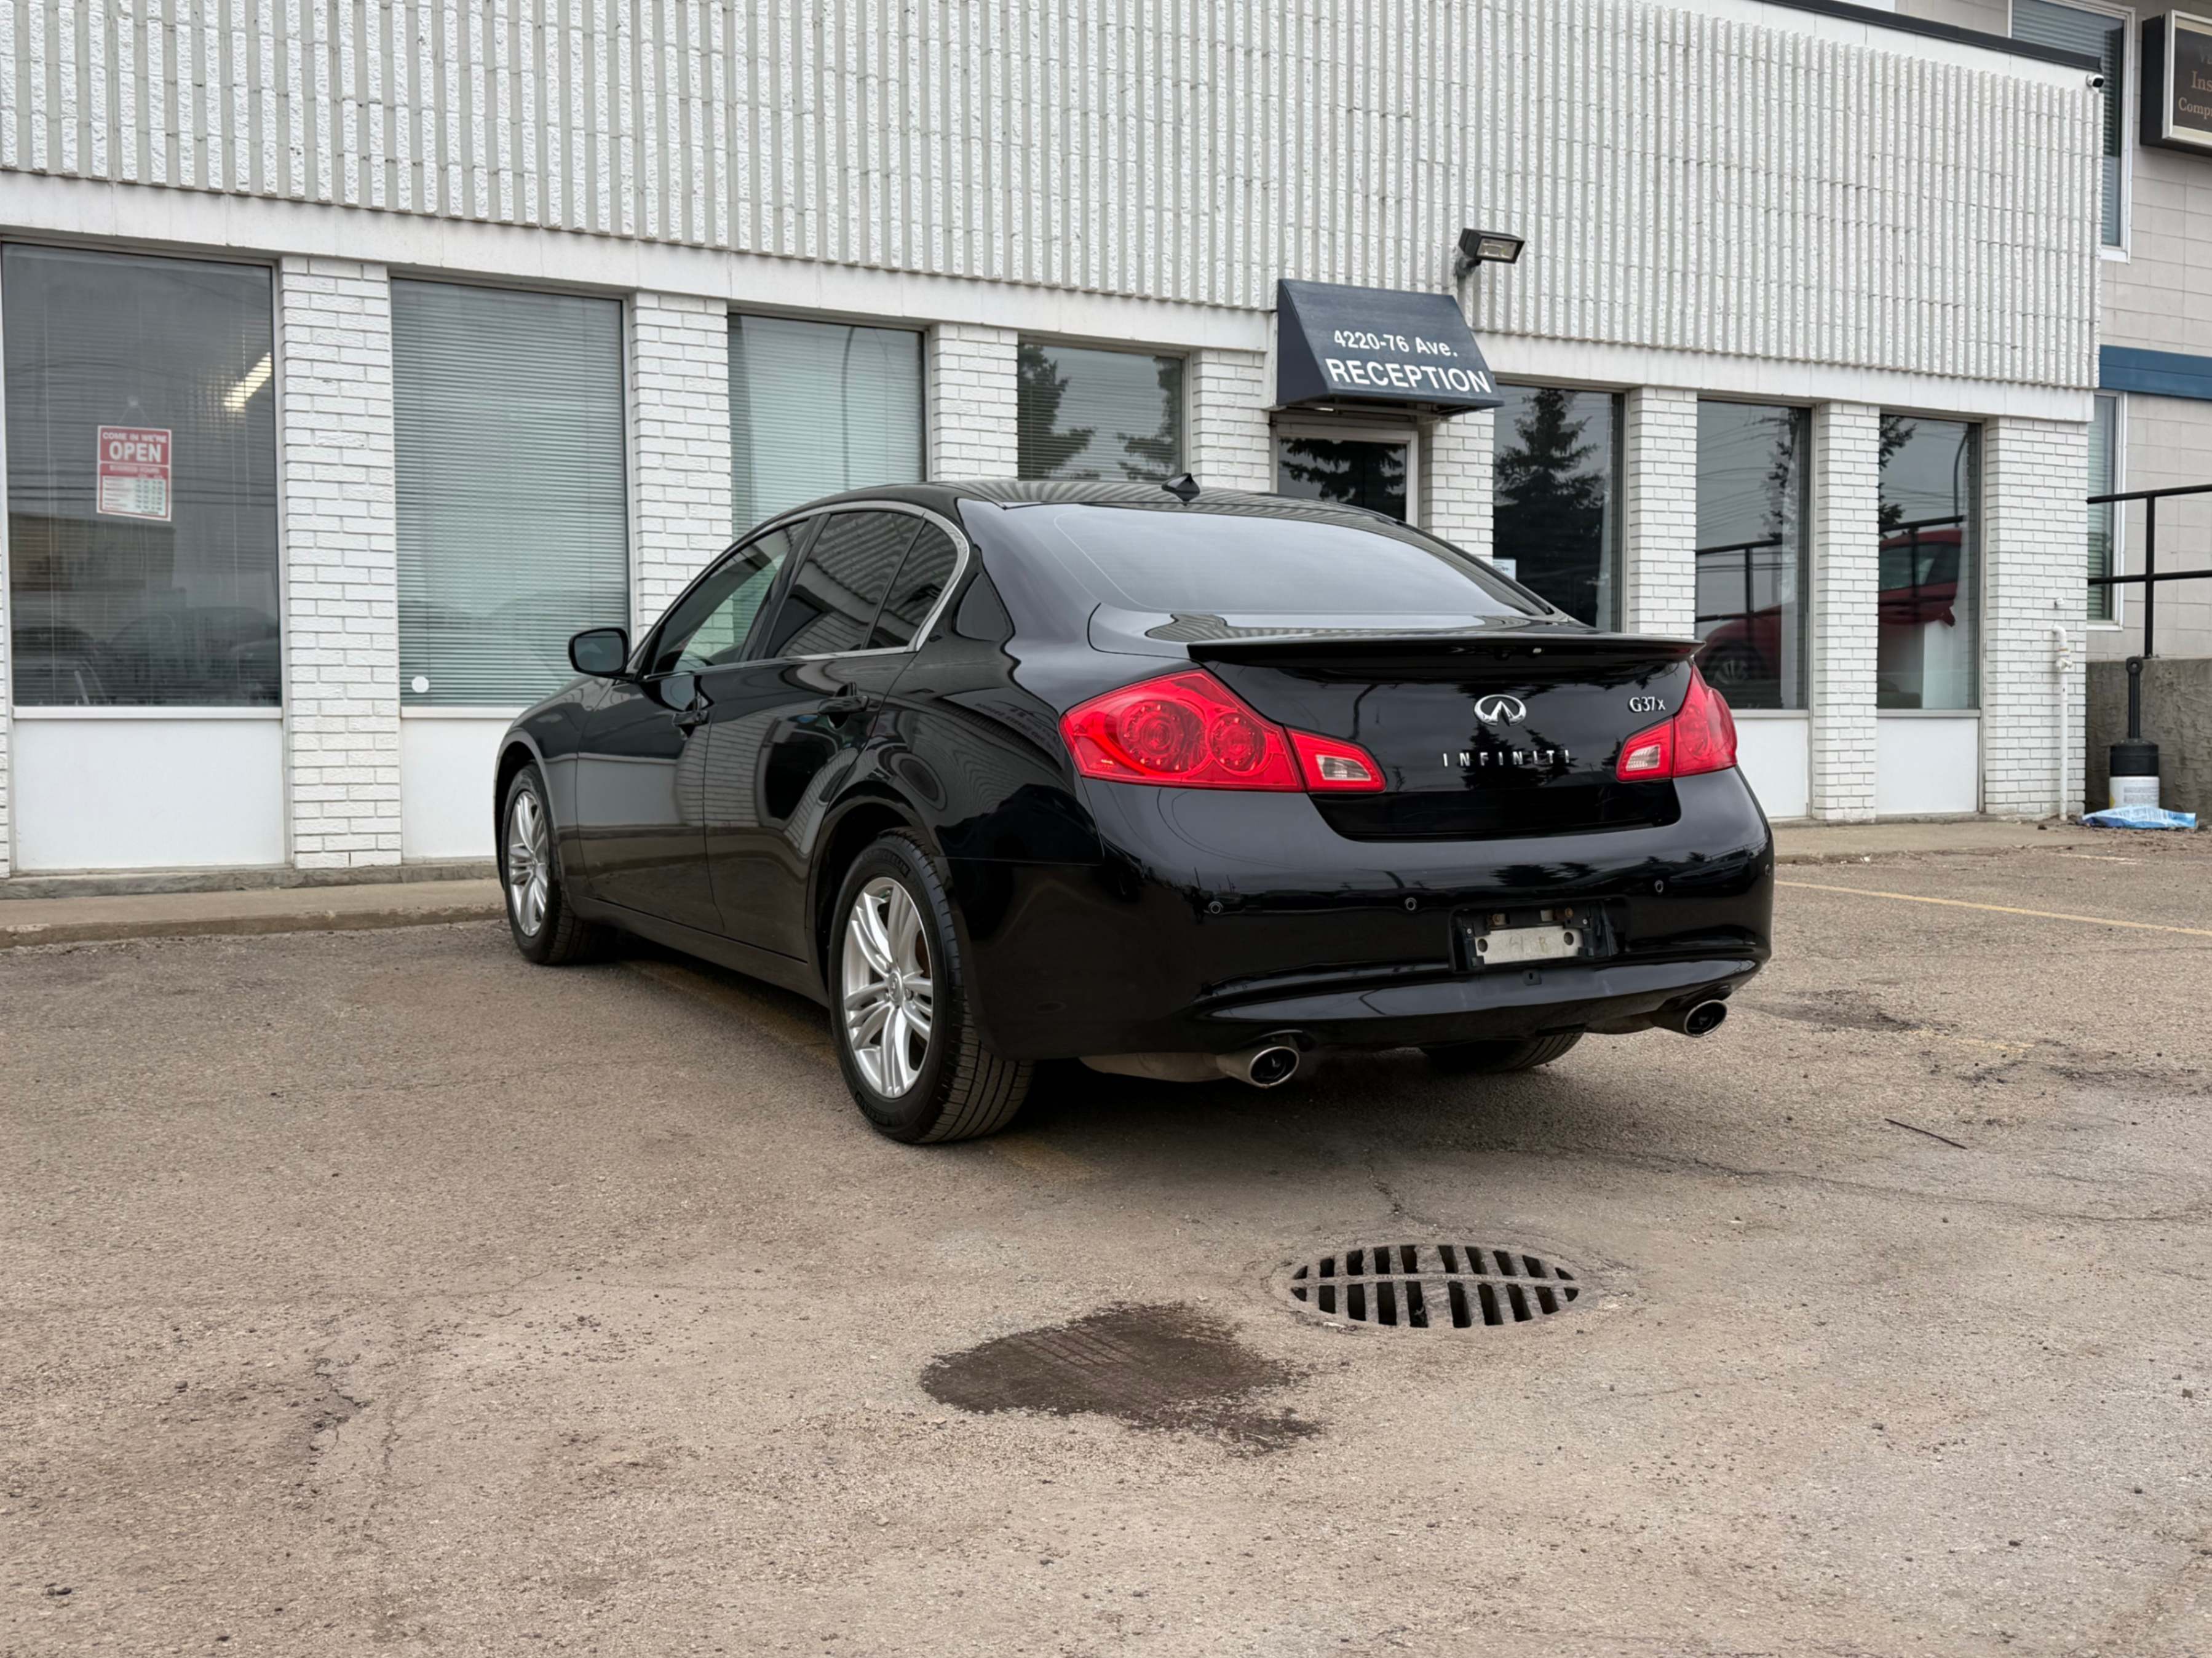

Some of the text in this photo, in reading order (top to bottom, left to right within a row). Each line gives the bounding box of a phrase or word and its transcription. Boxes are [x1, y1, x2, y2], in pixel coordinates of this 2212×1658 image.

[1334, 330, 1458, 357] 4220-76 Ave.
[1325, 358, 1492, 394] RECEPTION
[102, 432, 167, 443] COME IN WE'RE
[109, 441, 162, 462] OPEN
[1628, 696, 1666, 713] G37x
[1442, 749, 1571, 768] INFINITI
